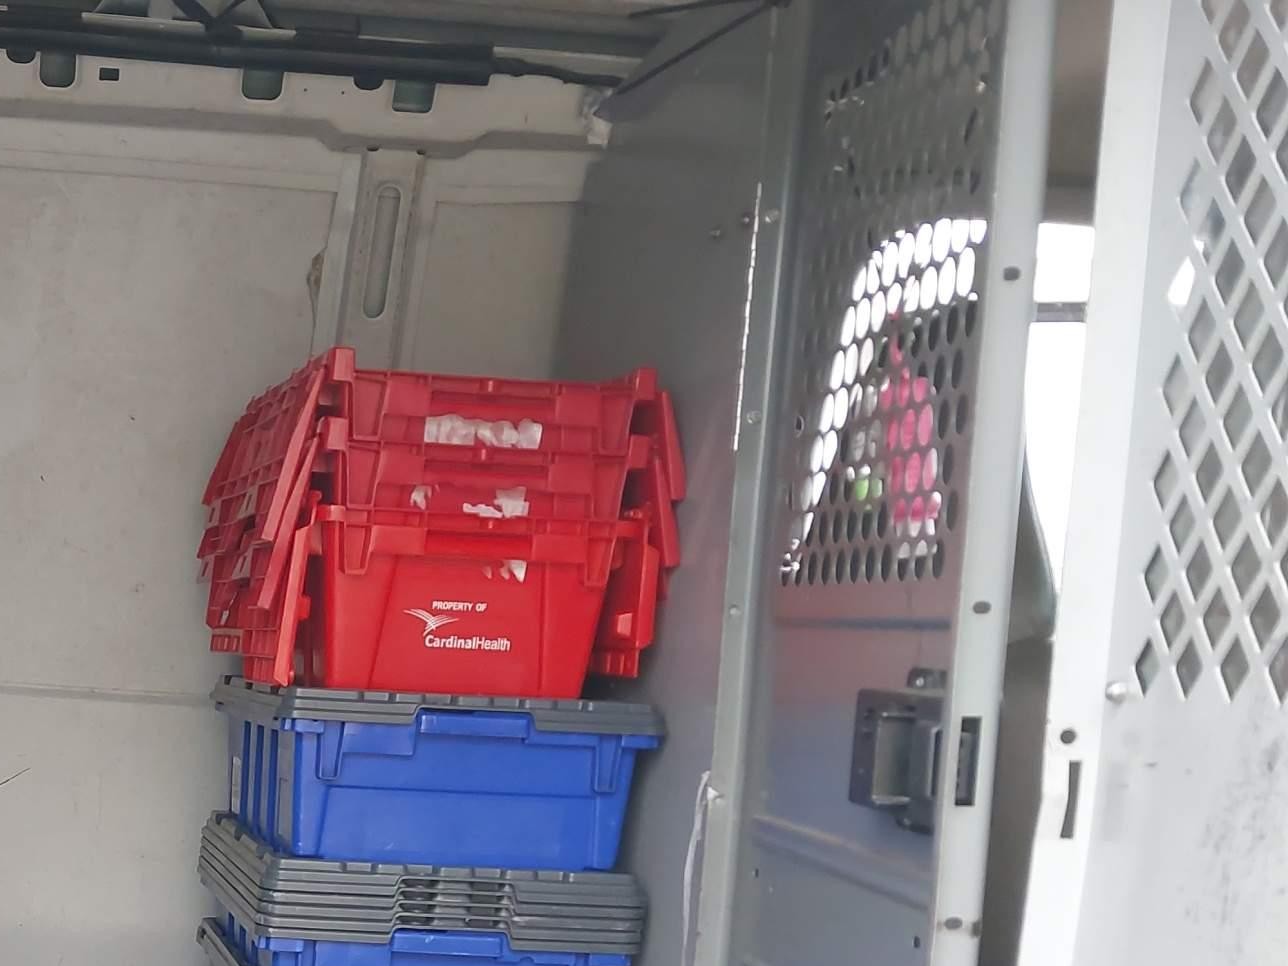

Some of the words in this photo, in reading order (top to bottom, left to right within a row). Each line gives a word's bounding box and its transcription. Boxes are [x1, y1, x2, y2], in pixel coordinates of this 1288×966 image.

[432, 600, 473, 611] PROPERTY
[475, 602, 487, 612] OF
[424, 635, 511, 651] CardinalHealth
